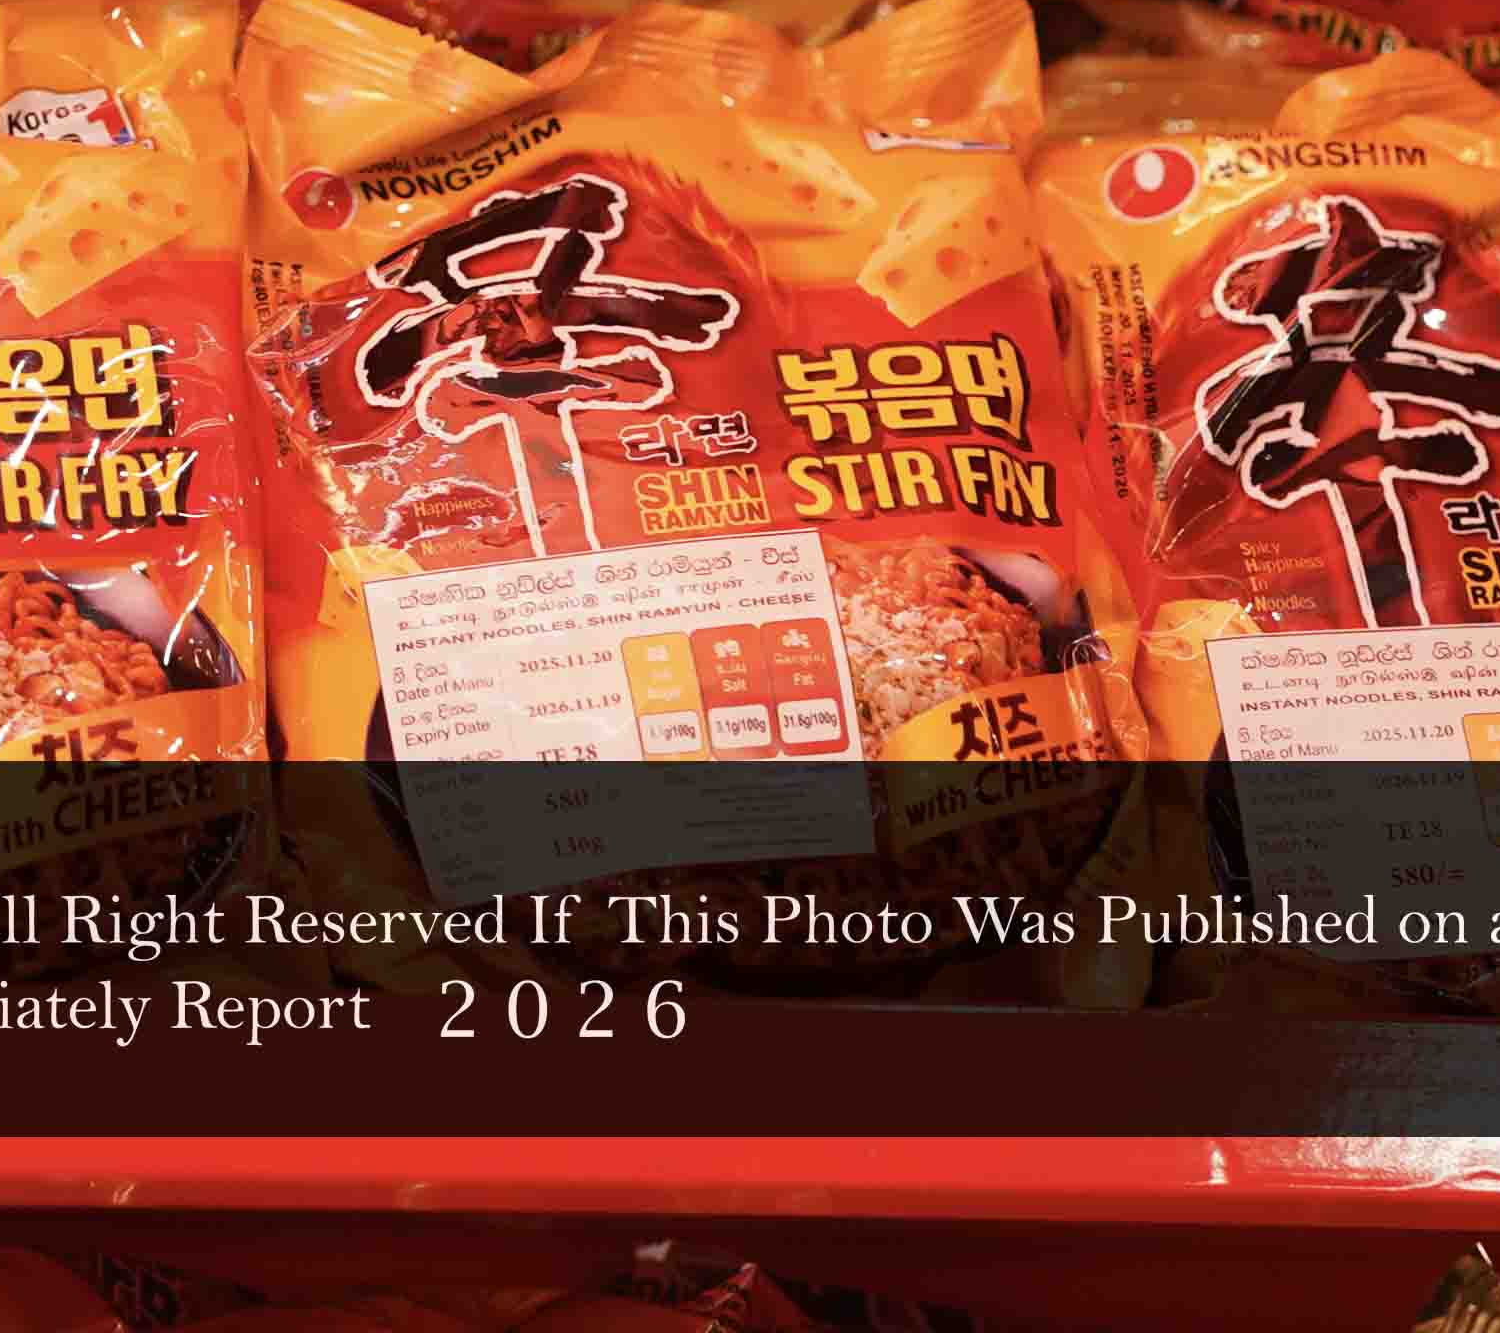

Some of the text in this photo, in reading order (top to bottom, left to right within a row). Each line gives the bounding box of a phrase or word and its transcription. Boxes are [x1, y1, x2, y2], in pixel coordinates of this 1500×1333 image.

[359, 116, 565, 204] NONGSHIM
[778, 334, 1030, 451] 볶음면
[618, 411, 759, 465] 라면
[60, 448, 191, 531] FRY
[635, 464, 765, 511] SHIN
[787, 445, 1062, 529] STIR FRY
[640, 501, 768, 534] RAMYUN
[395, 631, 478, 653] INSTANT
[635, 600, 723, 619] RAMYUN
[738, 591, 817, 608] CHEESE
[518, 650, 614, 674] 2025.11.20
[527, 693, 622, 719] 2026.11.19
[1239, 695, 1320, 714] INSTANT
[1428, 686, 1474, 701] SHIN
[1362, 724, 1455, 744] 2025.11.20
